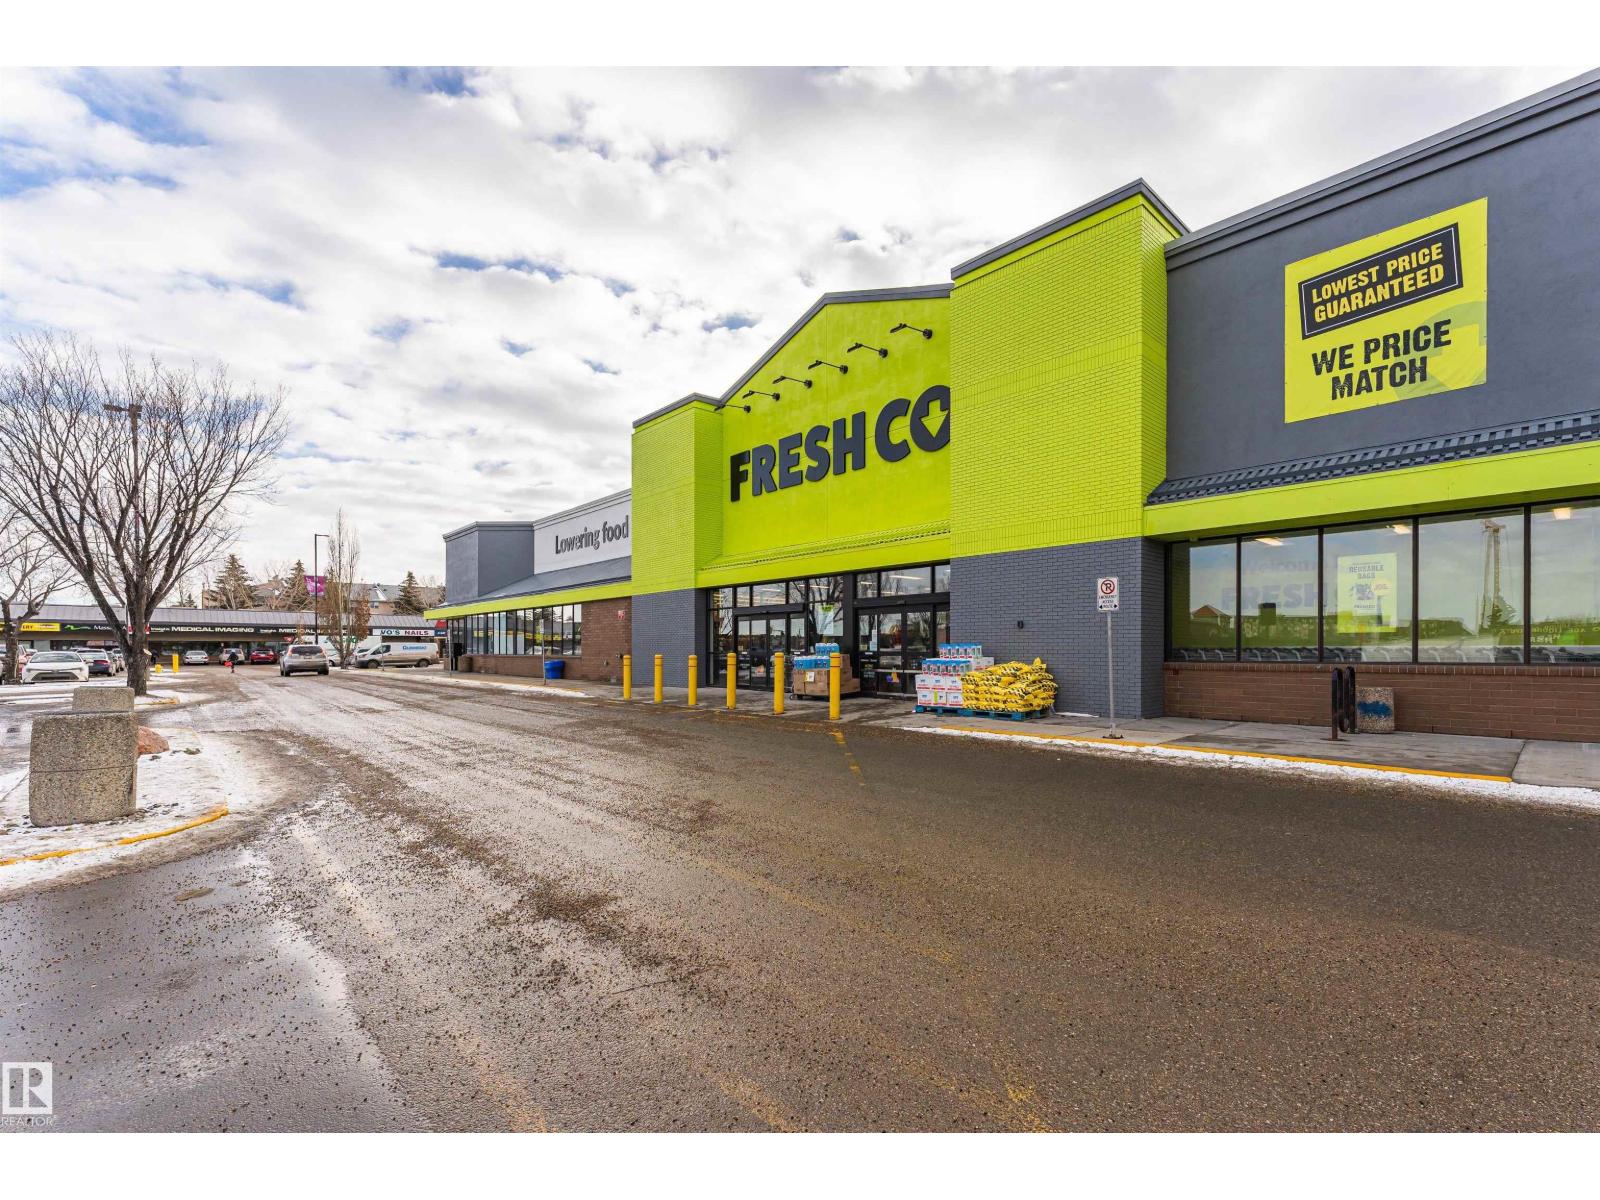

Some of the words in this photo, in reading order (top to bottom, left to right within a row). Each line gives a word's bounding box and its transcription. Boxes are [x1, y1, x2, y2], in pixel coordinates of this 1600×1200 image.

[1312, 265, 1379, 304] LOWEST
[1387, 242, 1444, 277] PRICE
[1314, 264, 1445, 323] GUARANTEED
[1311, 343, 1354, 376] WE
[1364, 319, 1452, 365] PRICE
[1331, 356, 1428, 401] MATCH
[555, 526, 600, 555] Lowering
[602, 514, 629, 544] food
